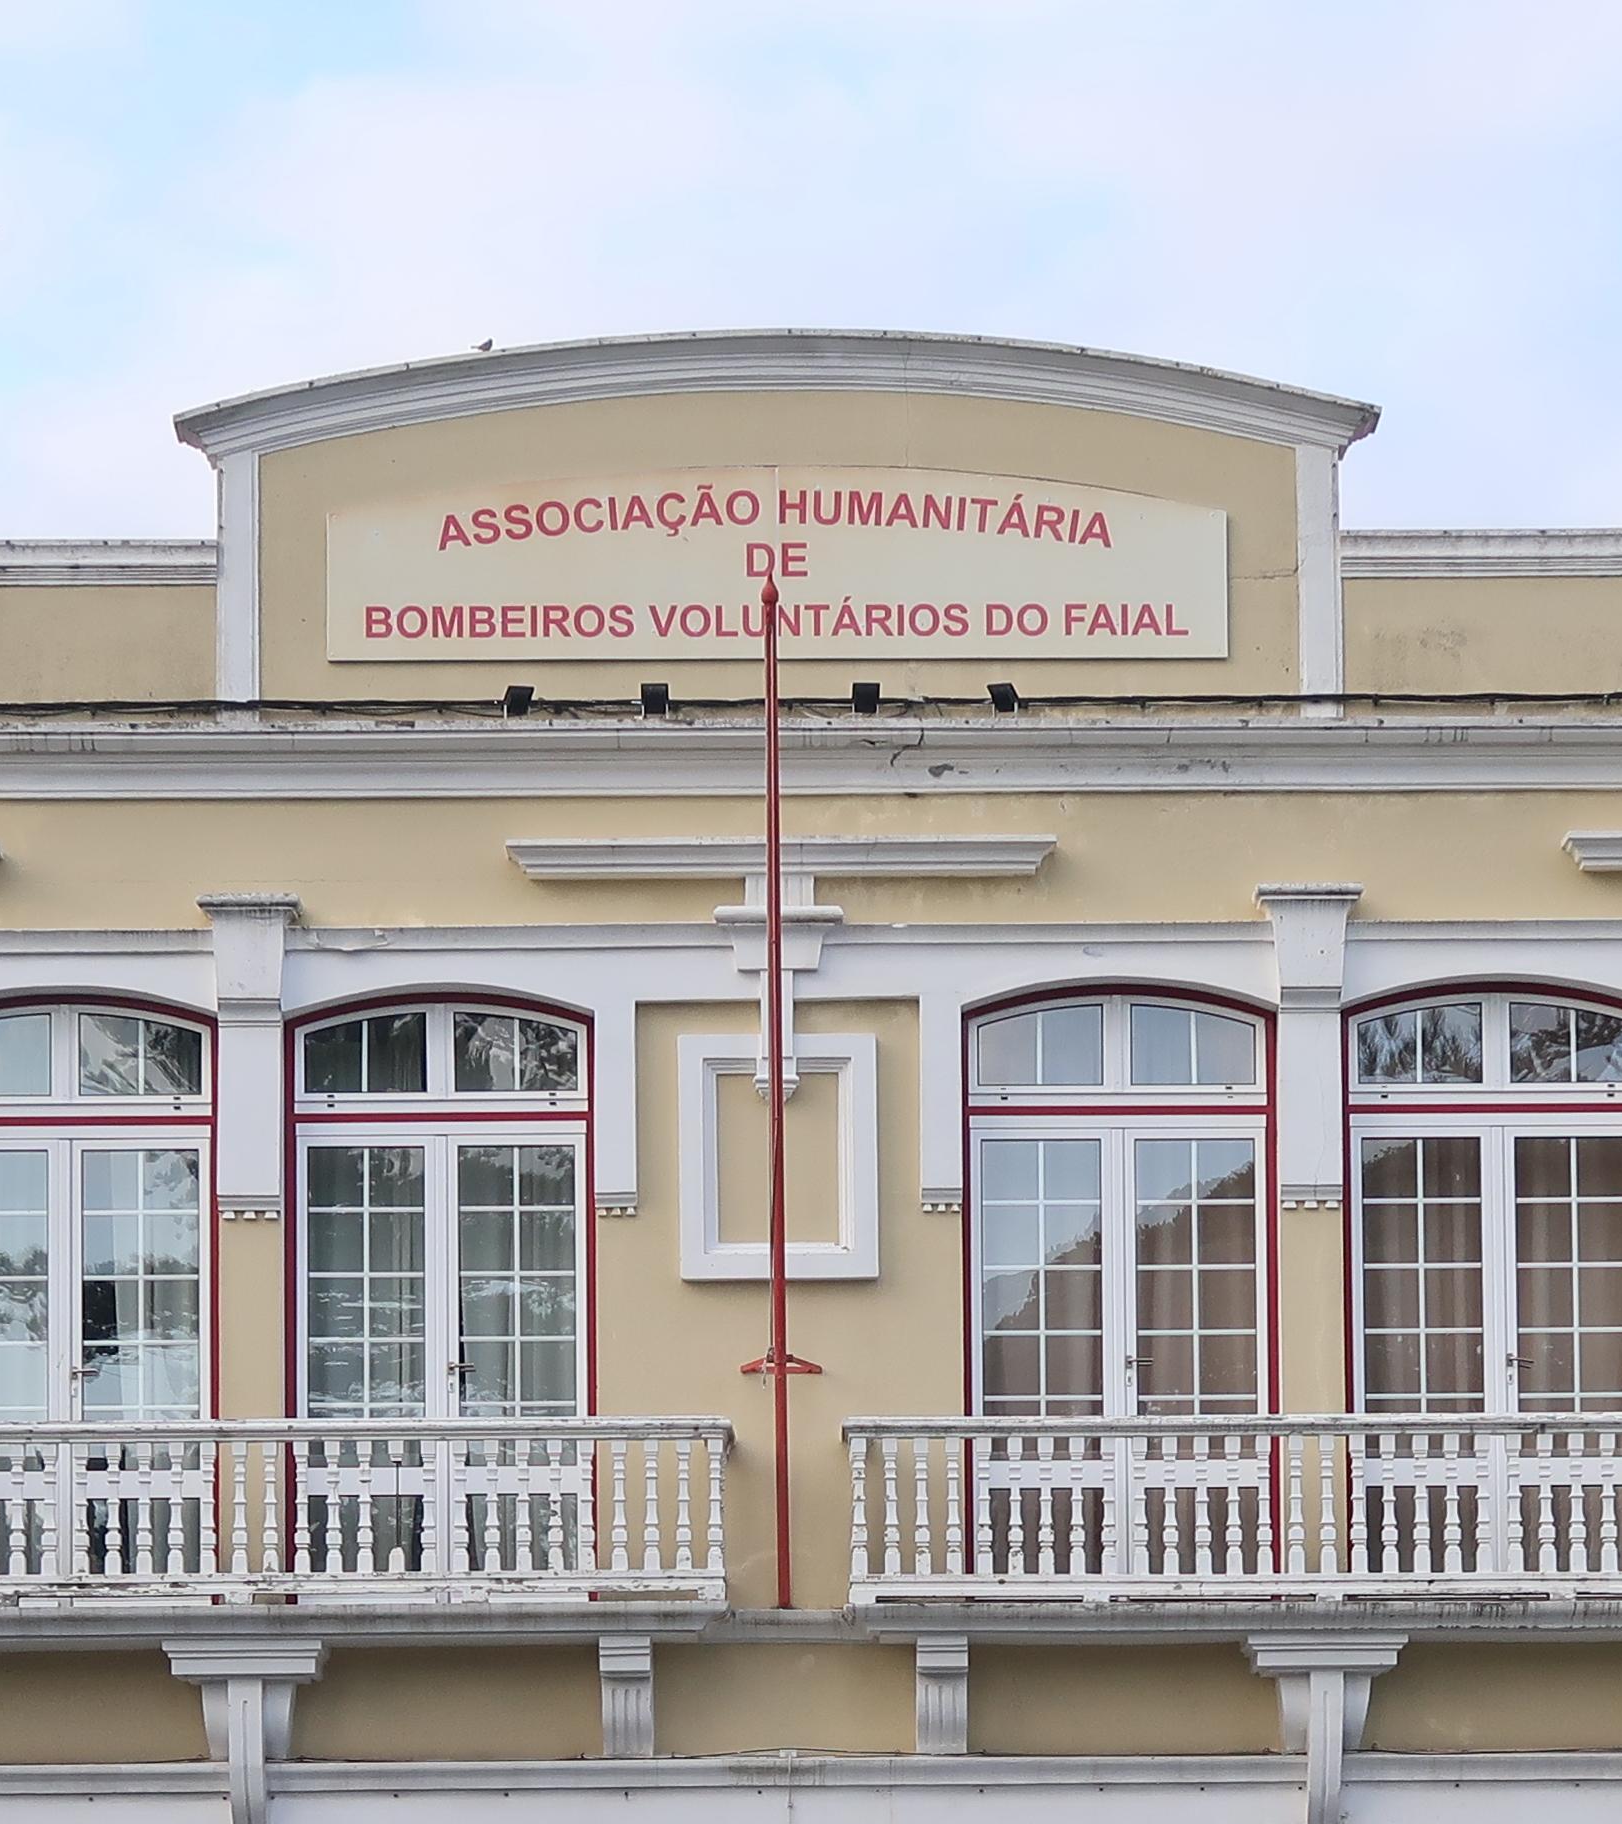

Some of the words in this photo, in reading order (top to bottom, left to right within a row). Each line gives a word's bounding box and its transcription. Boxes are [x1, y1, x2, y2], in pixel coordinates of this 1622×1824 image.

[439, 483, 761, 549] ASSOCIAÇÃO
[778, 489, 1112, 548] HUMANITÁRIA
[745, 543, 809, 577] DE
[365, 604, 636, 639] BOMBEIROS
[650, 596, 971, 638] VOLUNTÁRIOS
[986, 603, 1049, 637] DO
[1065, 603, 1187, 636] FAIAL
